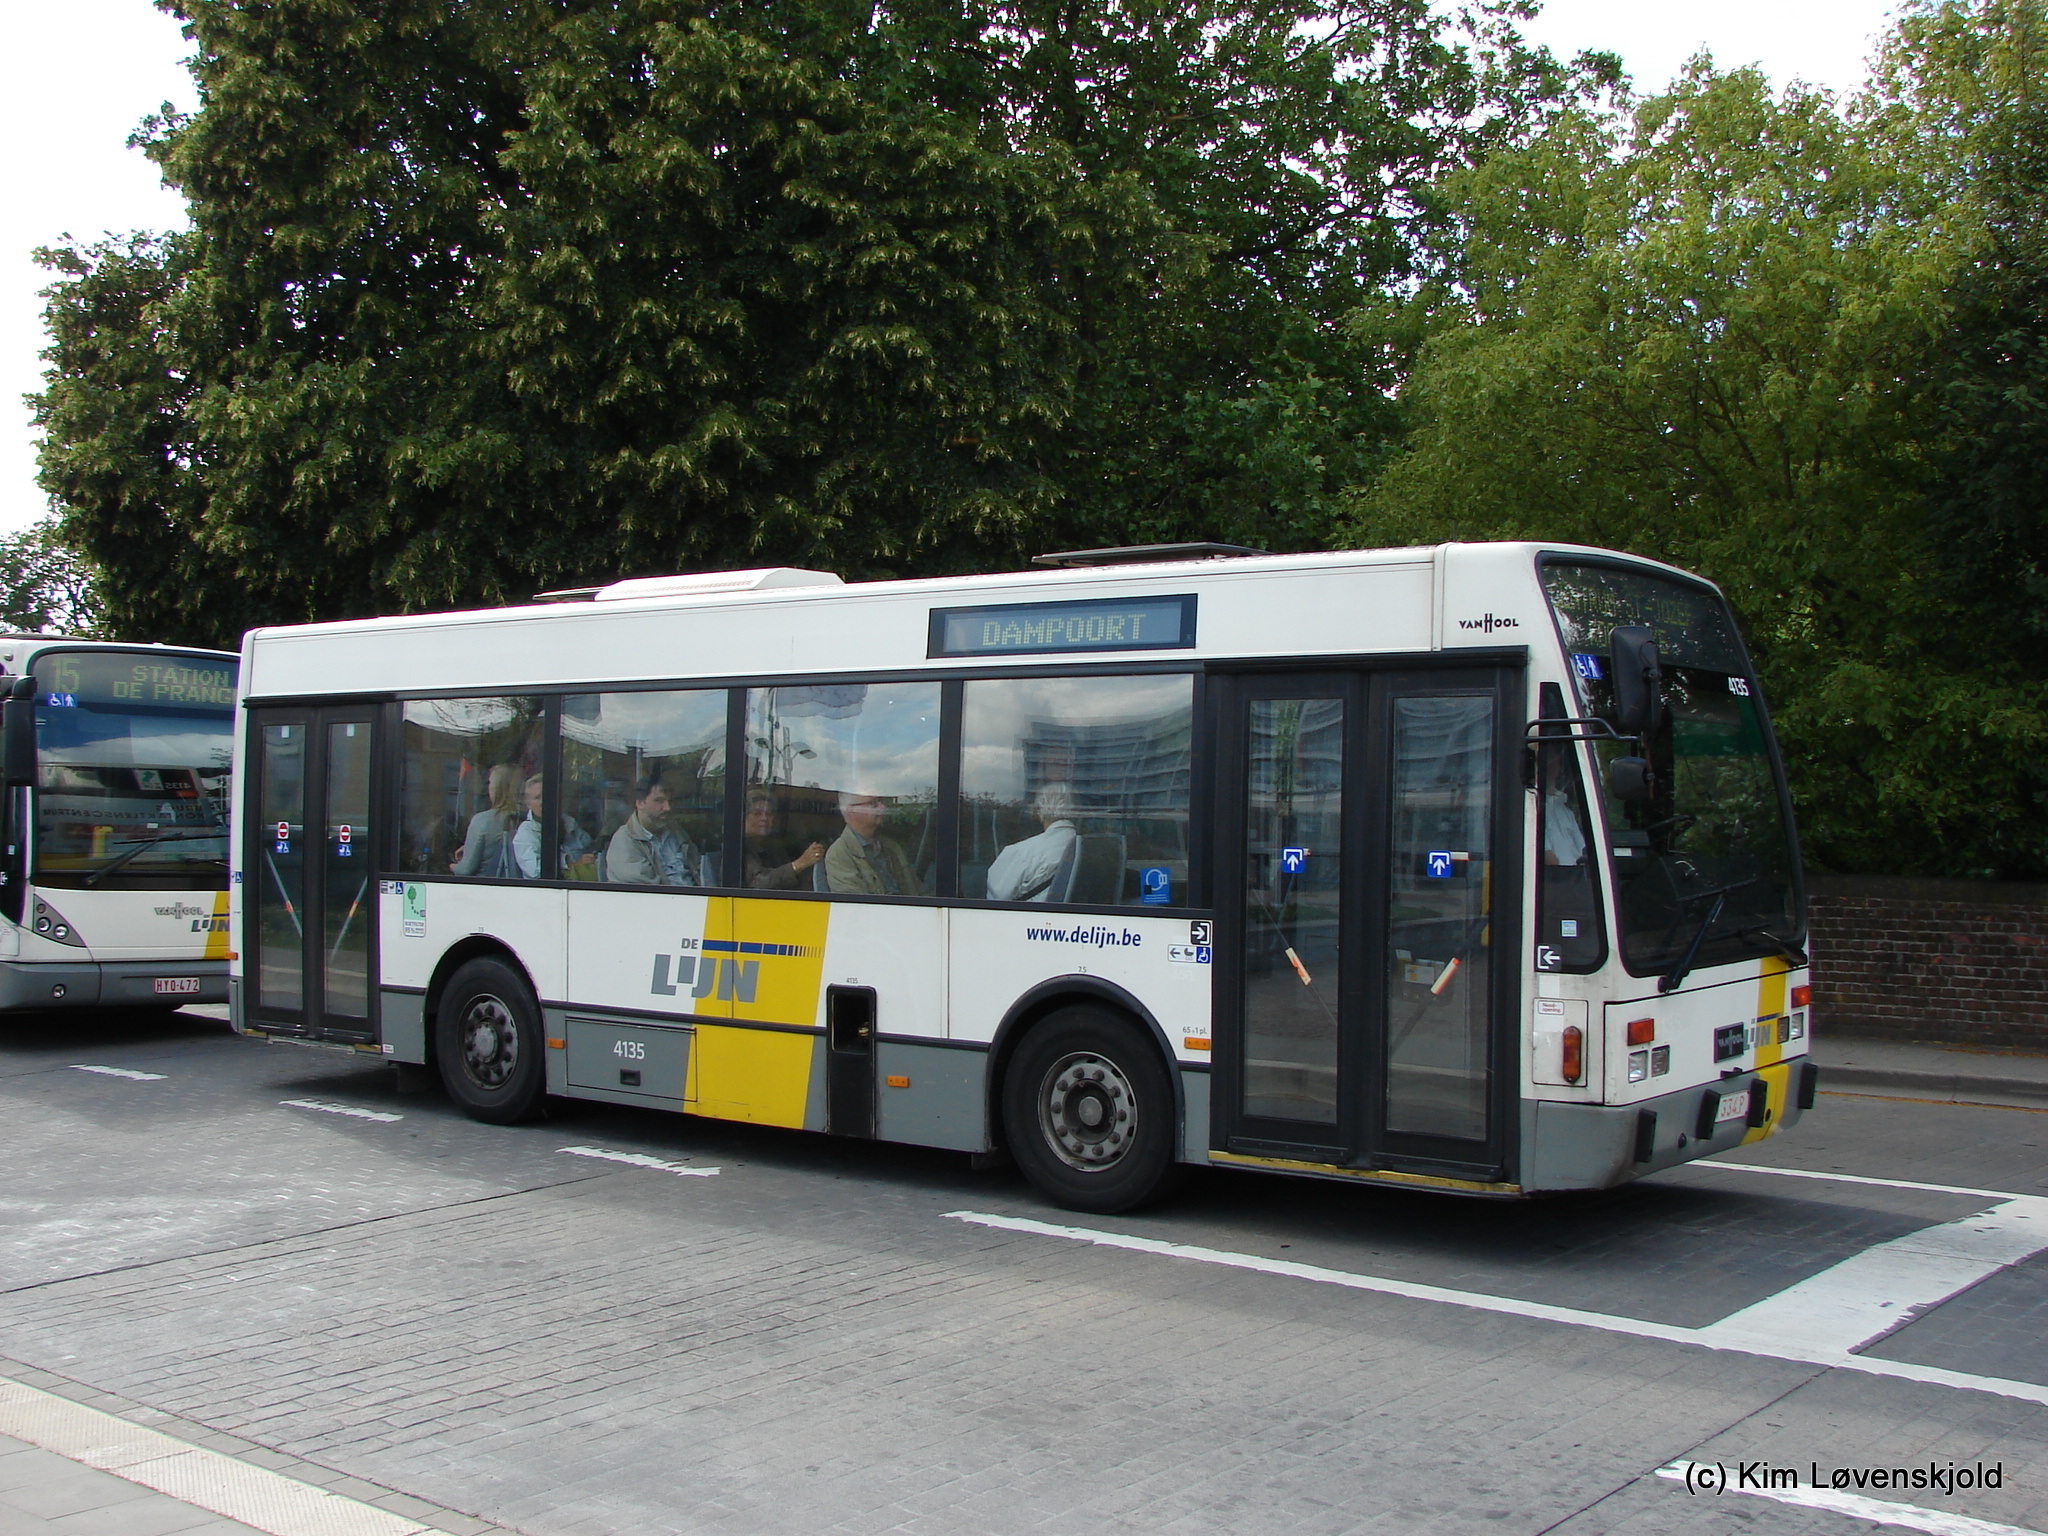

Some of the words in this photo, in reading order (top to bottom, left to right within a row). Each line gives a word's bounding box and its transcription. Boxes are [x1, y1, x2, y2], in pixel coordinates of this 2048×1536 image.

[982, 613, 1146, 647] DAMPOORT
[52, 657, 81, 694] 15
[132, 665, 230, 688] STATION
[113, 680, 144, 699] DE
[1728, 677, 1750, 697] 4135
[681, 938, 698, 951] DE
[1026, 926, 1142, 948] www.delijn.be
[651, 953, 760, 1003] LIJN
[612, 1039, 646, 1060] 4135
